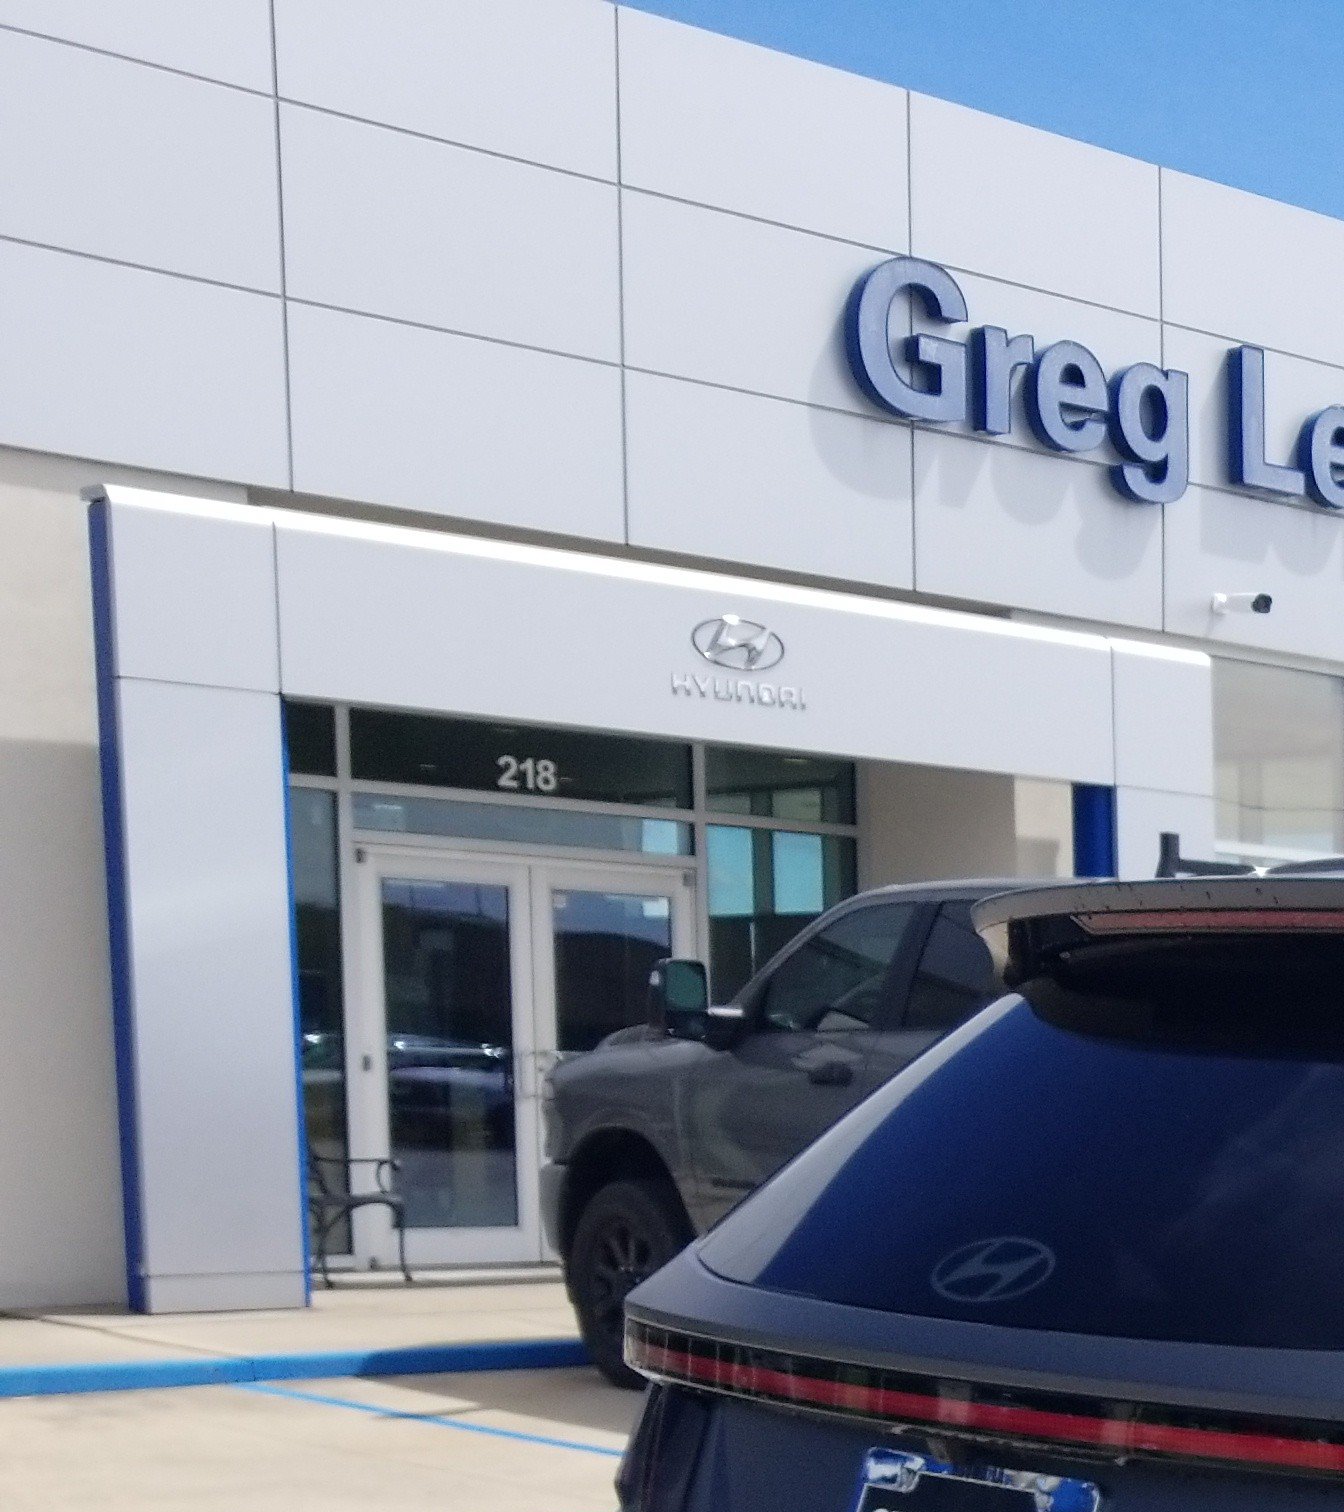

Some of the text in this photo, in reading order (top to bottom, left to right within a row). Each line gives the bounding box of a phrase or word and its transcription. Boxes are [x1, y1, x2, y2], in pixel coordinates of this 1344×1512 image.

[844, 256, 1189, 504] Greg
[671, 672, 806, 710] HYUNDAI
[497, 754, 556, 791] 218
